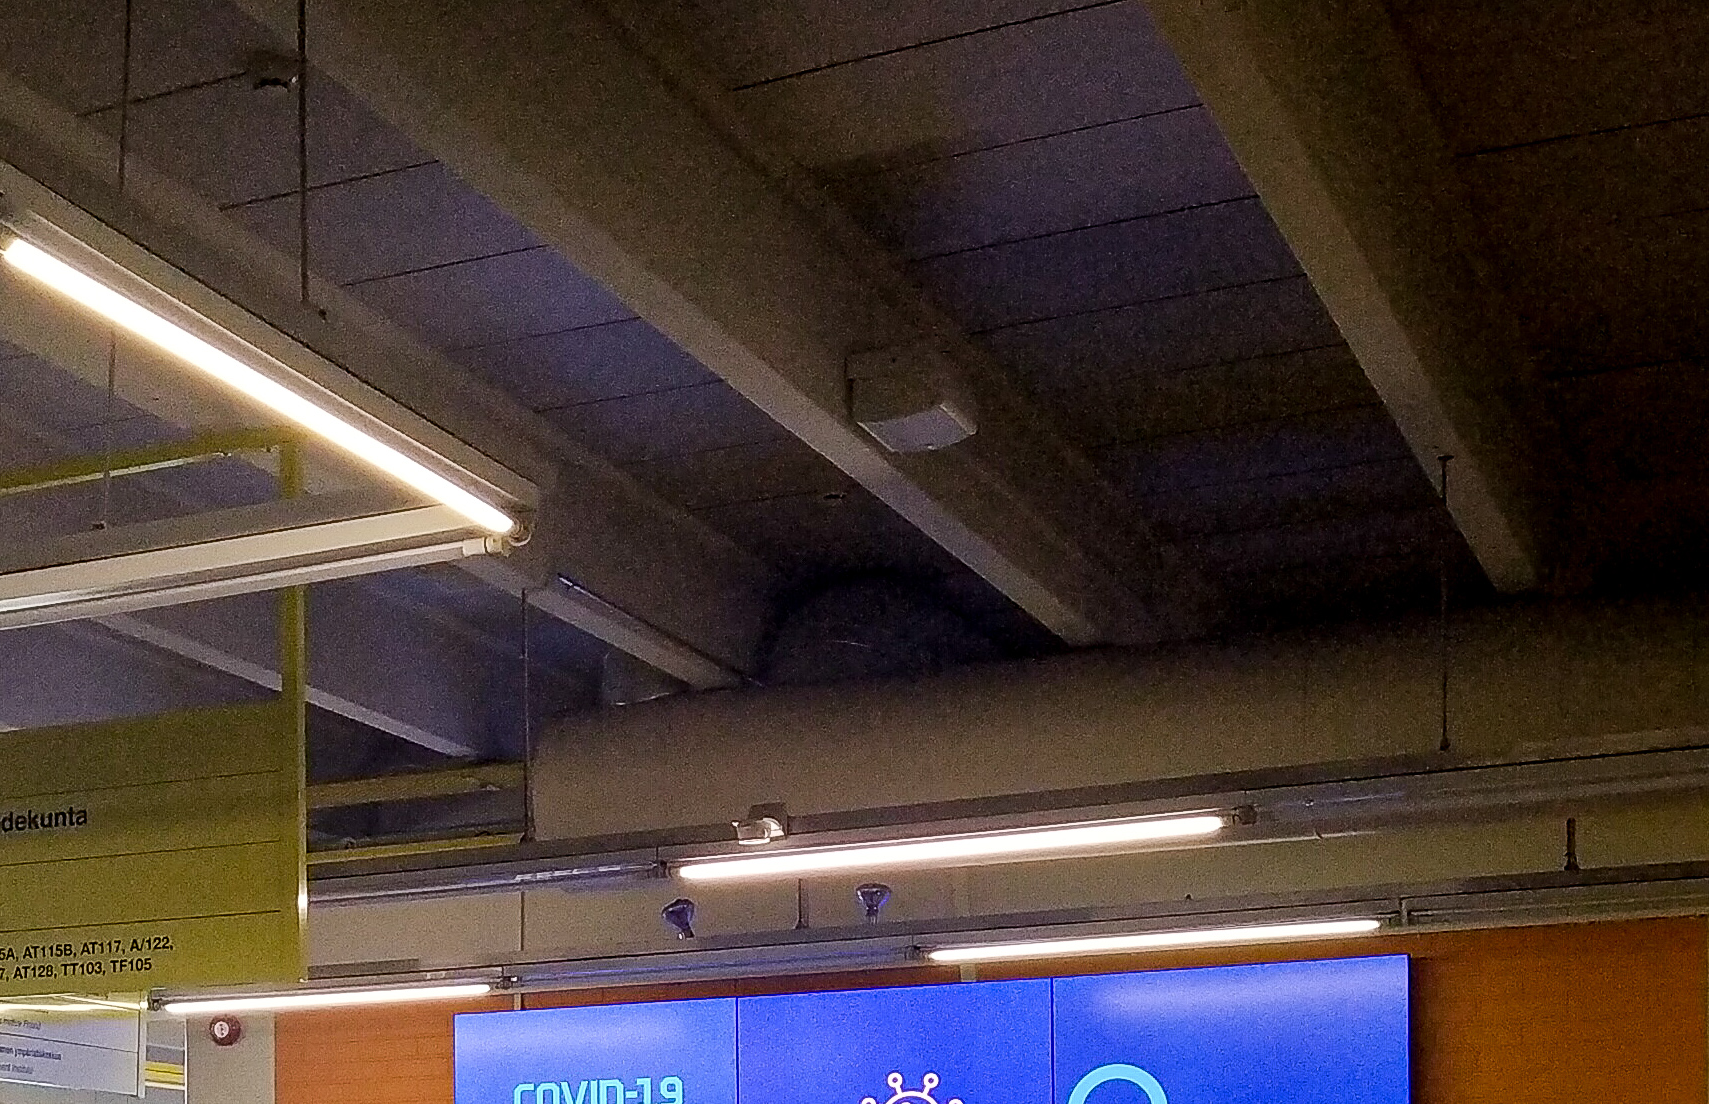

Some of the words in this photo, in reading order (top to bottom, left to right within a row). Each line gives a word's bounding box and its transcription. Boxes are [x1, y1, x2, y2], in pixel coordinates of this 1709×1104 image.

[23, 943, 77, 959] AT115B,
[80, 940, 127, 956] AT117,
[13, 964, 59, 981] AT128,
[61, 961, 107, 977] TT103,
[110, 957, 152, 973] TF105
